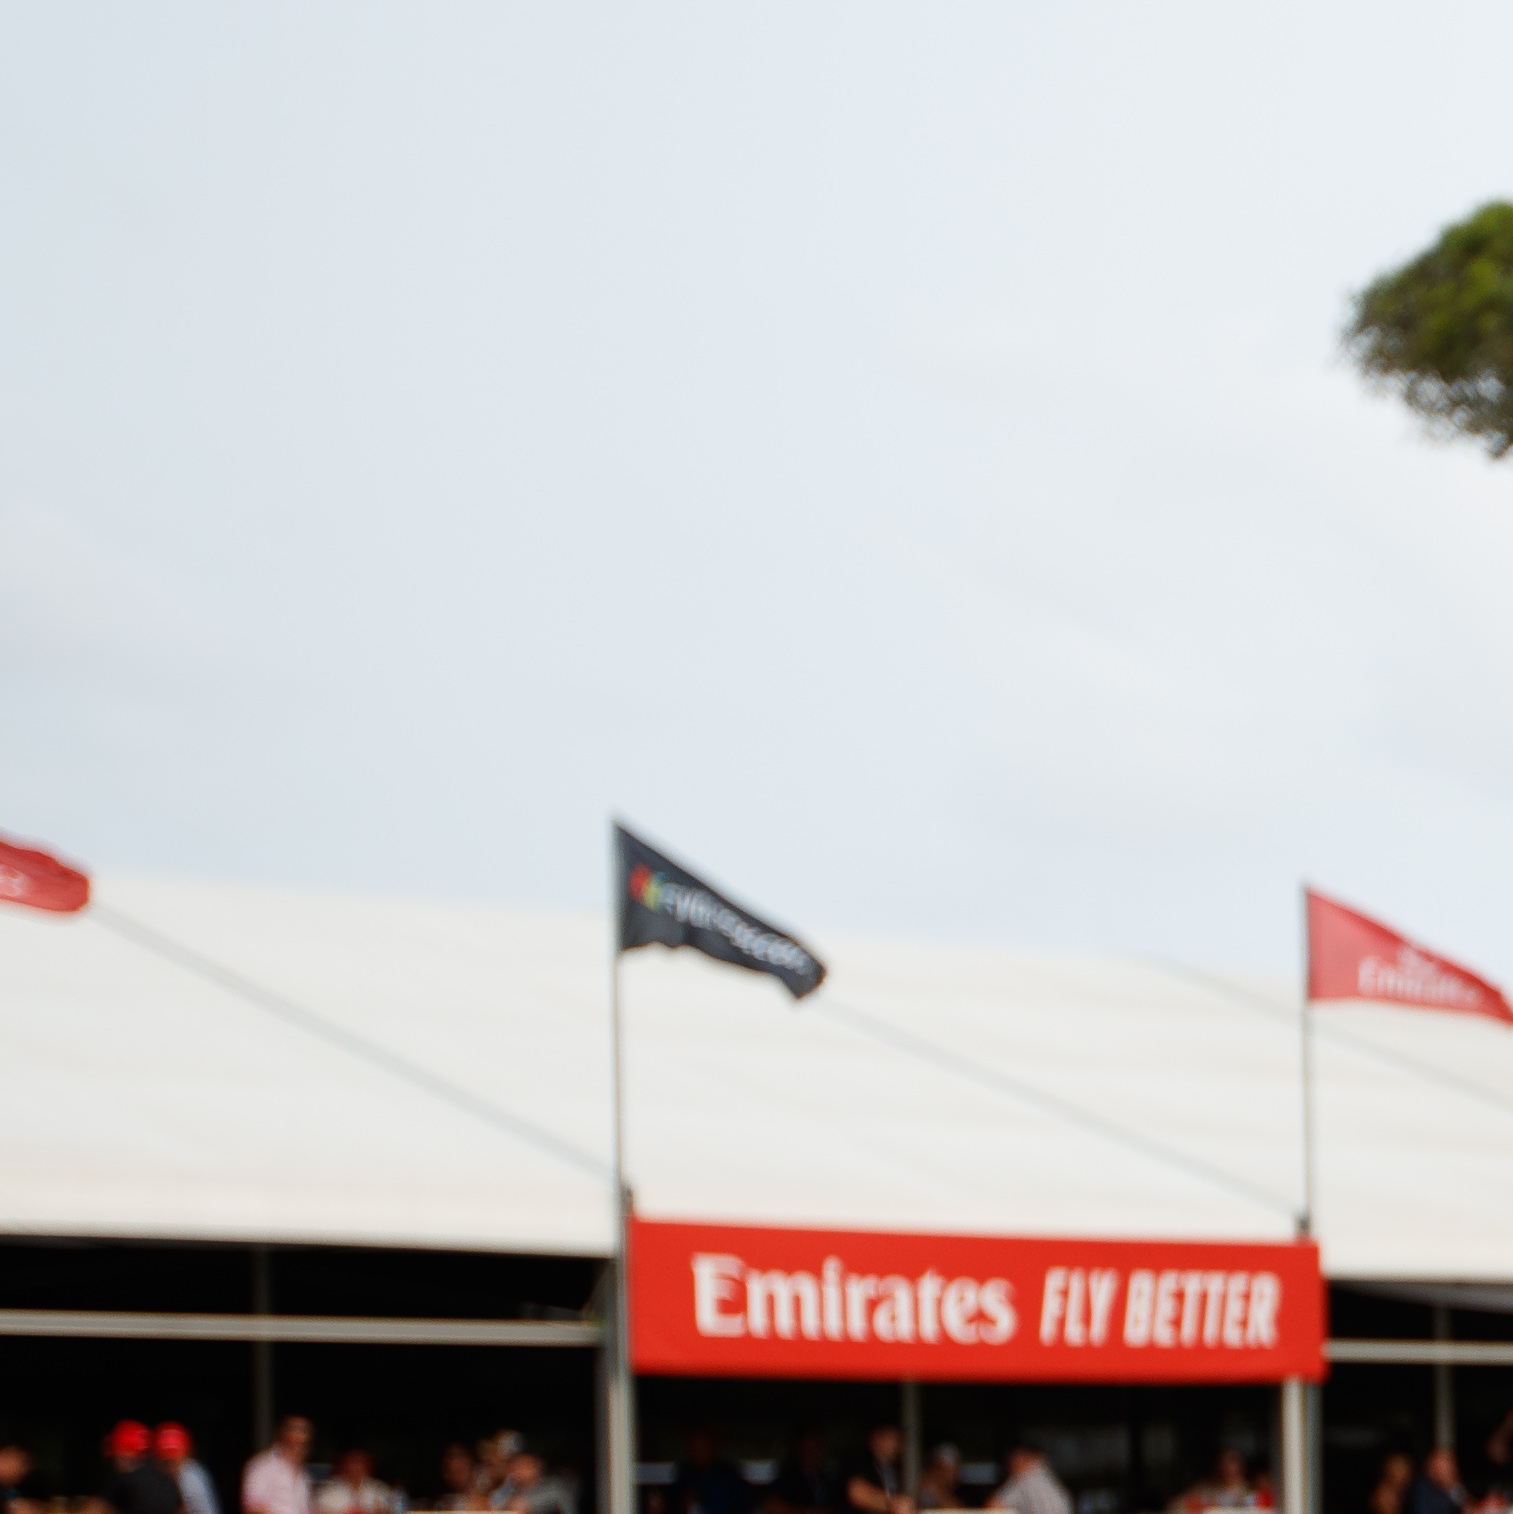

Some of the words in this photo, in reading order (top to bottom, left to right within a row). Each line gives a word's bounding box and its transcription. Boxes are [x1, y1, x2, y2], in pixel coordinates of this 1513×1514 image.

[691, 1251, 1018, 1346] Emirates
[1039, 1266, 1121, 1347] FLY
[1122, 1269, 1282, 1350] BETTER
